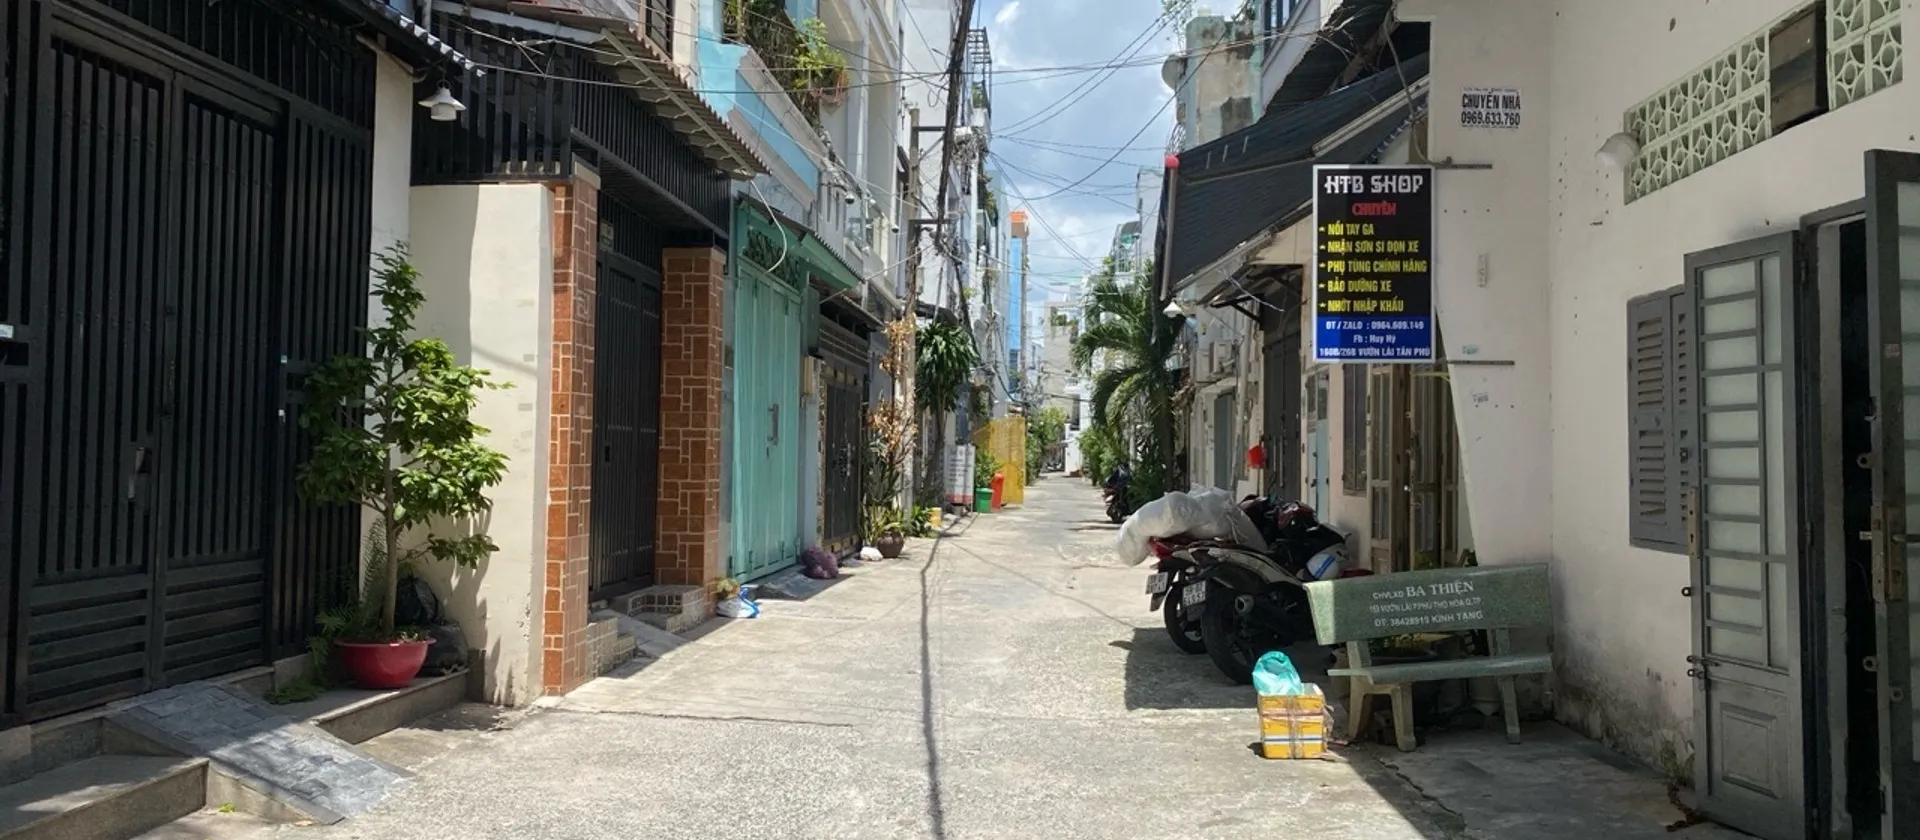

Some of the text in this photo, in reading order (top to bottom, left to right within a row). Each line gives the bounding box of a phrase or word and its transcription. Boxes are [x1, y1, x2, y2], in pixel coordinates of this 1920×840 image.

[1461, 111, 1520, 126] 0969.633.760
[1324, 175, 1424, 194] HTB SHOP
[1346, 223, 1360, 236] TAY
[1362, 223, 1374, 236] GA
[1355, 240, 1374, 253] SƠN
[1408, 240, 1420, 253] XE
[1328, 260, 1345, 275] PHỤ
[1373, 258, 1400, 272] CHÍNH
[1328, 276, 1346, 292] BẢO
[1380, 280, 1392, 292] XE
[1342, 320, 1362, 330] ZALO
[1353, 334, 1363, 343] Fb
[1370, 334, 1384, 344] Huy
[1428, 580, 1474, 596] THIỆN
